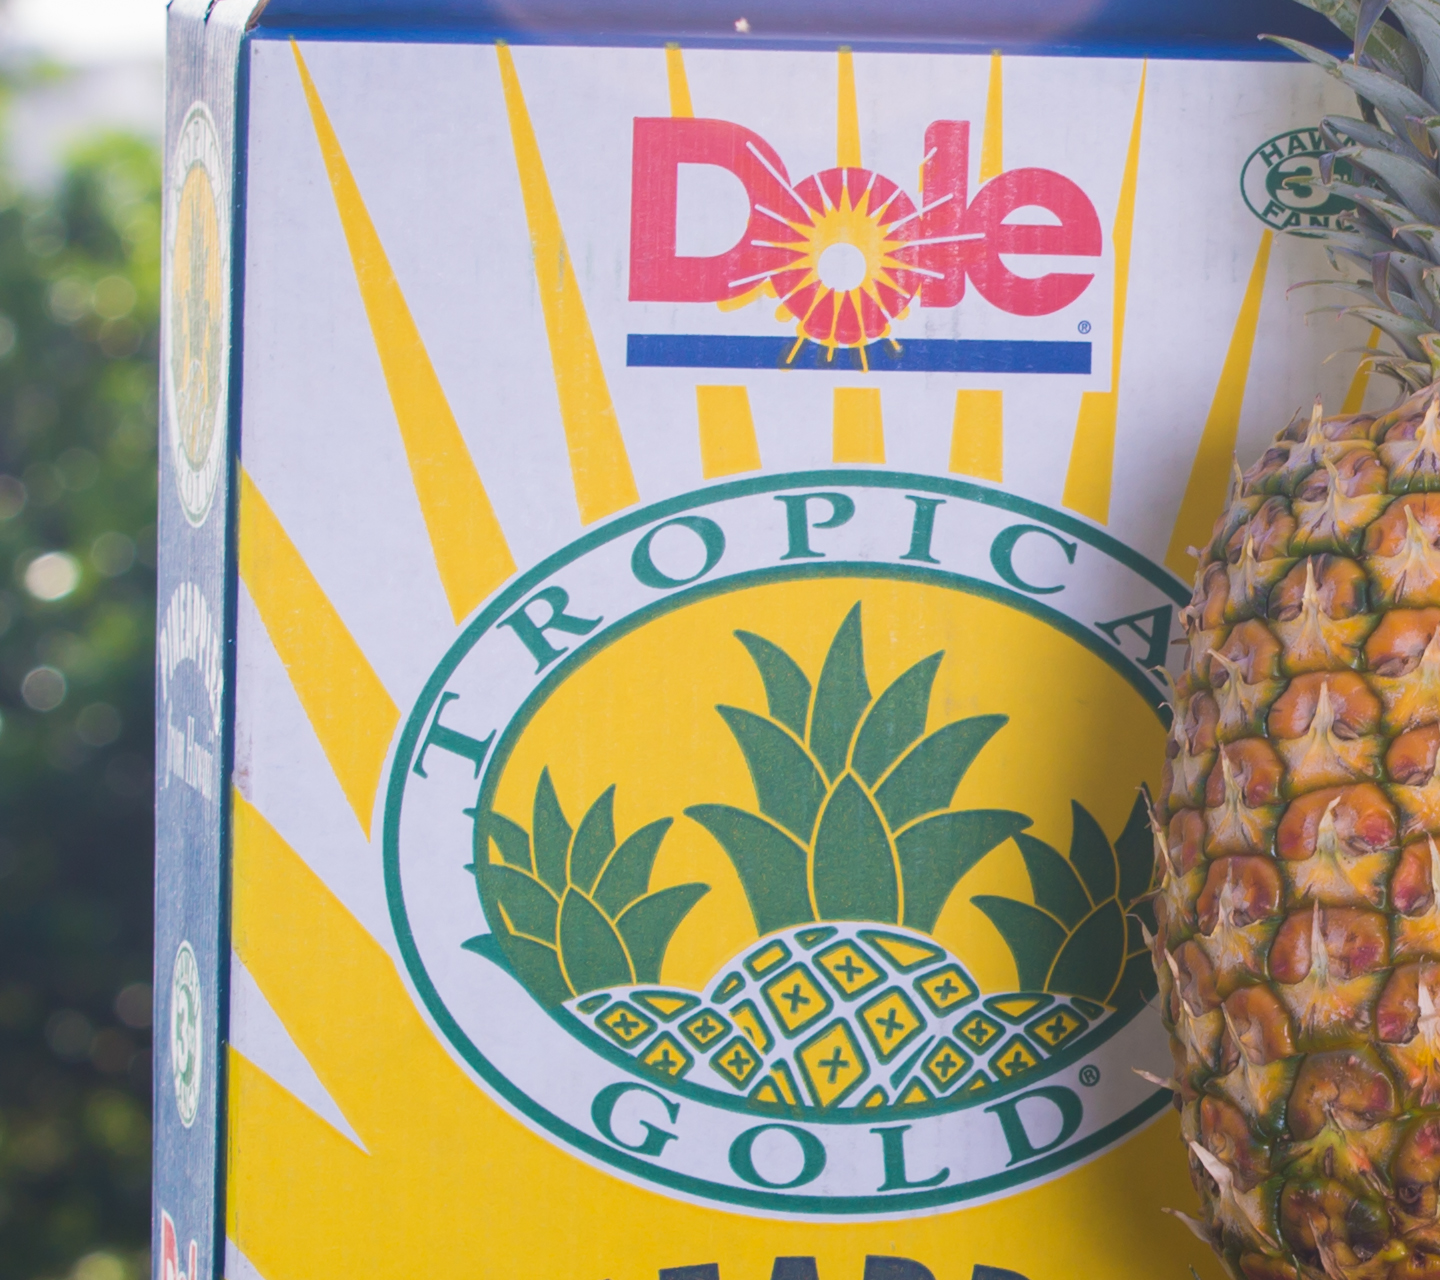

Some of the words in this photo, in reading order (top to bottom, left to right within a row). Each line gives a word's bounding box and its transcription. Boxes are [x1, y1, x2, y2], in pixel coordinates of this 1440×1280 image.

[628, 116, 1103, 345] Dole
[413, 492, 1173, 780] TROPICA
[591, 1080, 1083, 1192] GOLD
